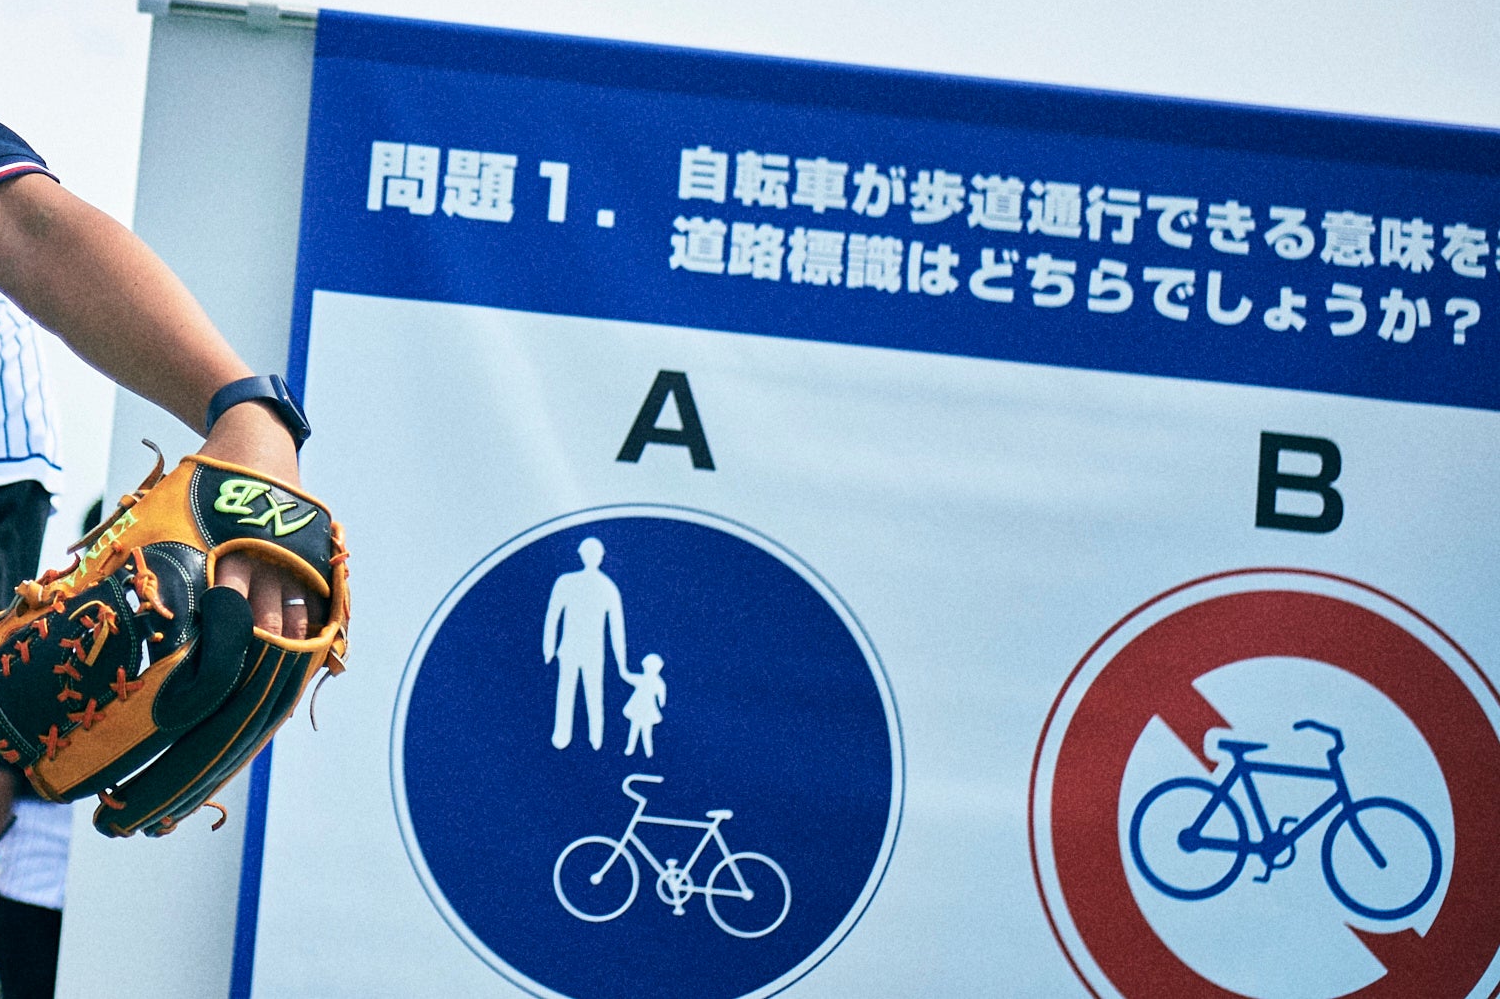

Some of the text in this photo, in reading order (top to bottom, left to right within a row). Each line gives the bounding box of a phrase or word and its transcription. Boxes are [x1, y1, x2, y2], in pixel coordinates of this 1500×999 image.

[677, 145, 1500, 279] 自転車が歩道通行できる意味を
[615, 369, 716, 471] A
[1255, 430, 1345, 535] B
